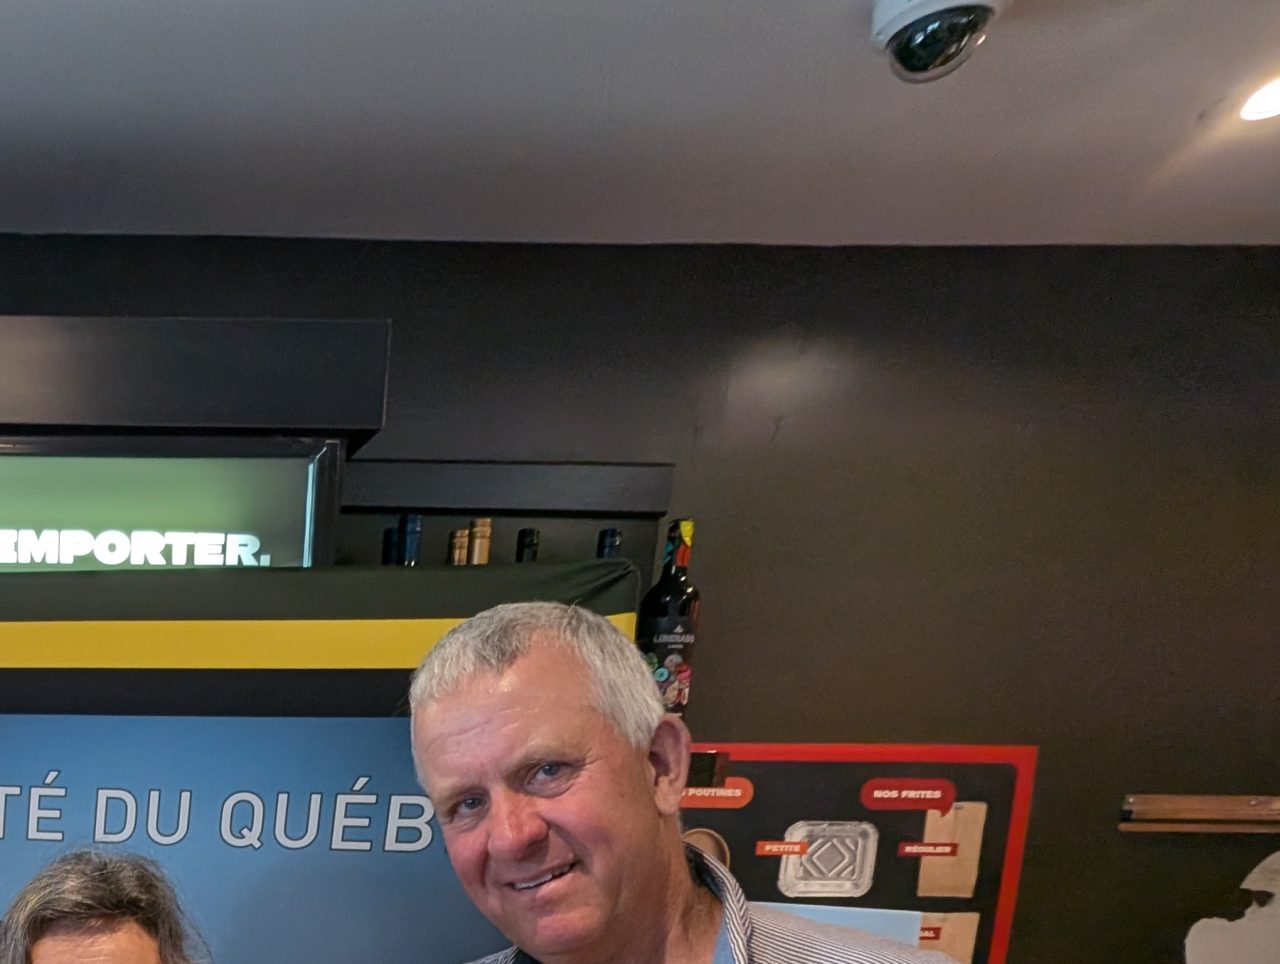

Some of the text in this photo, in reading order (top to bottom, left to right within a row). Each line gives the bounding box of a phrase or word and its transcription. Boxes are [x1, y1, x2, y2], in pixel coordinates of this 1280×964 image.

[93, 787, 192, 846] DU
[219, 775, 437, 853] QUÉB
[873, 790, 942, 798] NOS FRITES
